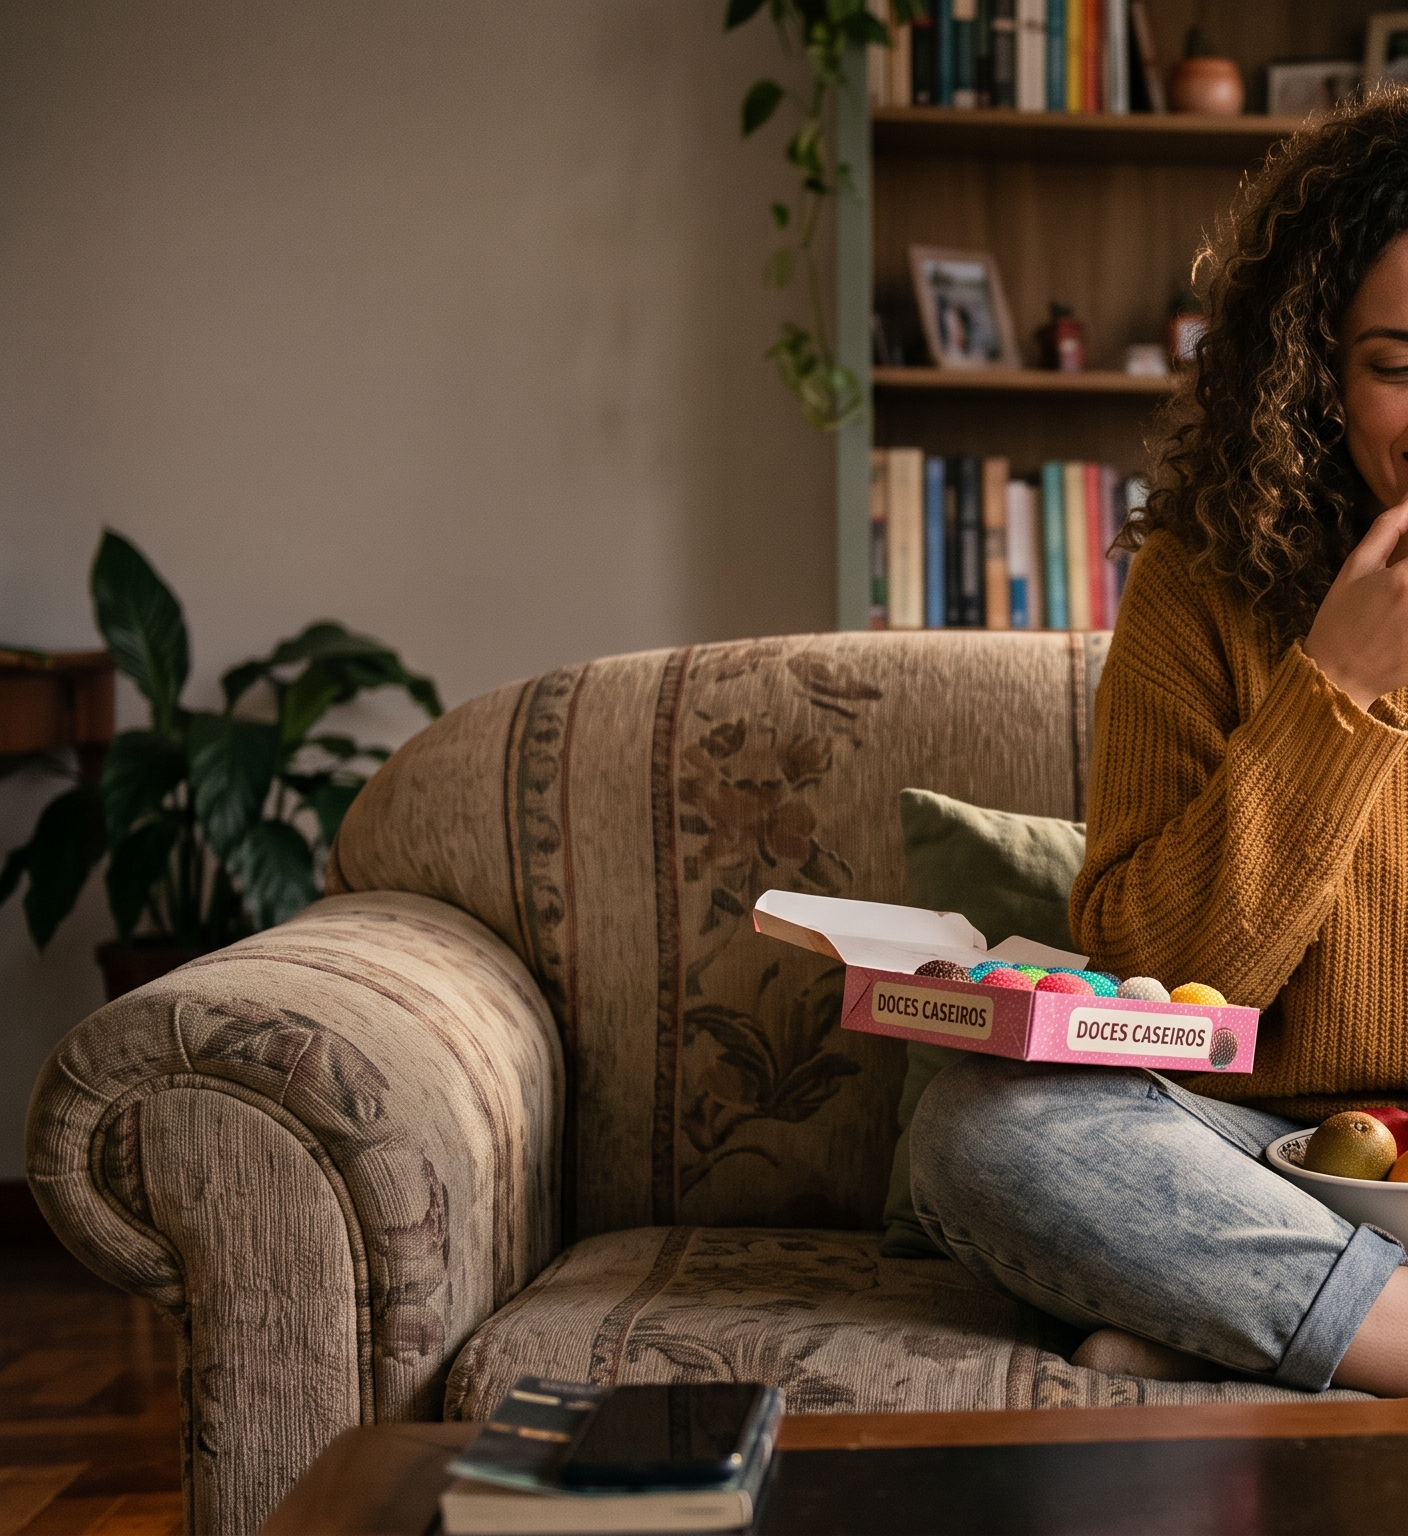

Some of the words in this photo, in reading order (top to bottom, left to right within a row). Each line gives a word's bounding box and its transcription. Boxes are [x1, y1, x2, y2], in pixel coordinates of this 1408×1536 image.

[878, 994, 919, 1017] DOCES
[922, 1000, 987, 1028] CASEIROS
[1076, 1020, 1129, 1042] DOCES
[1132, 1024, 1206, 1047] CASEIROS
